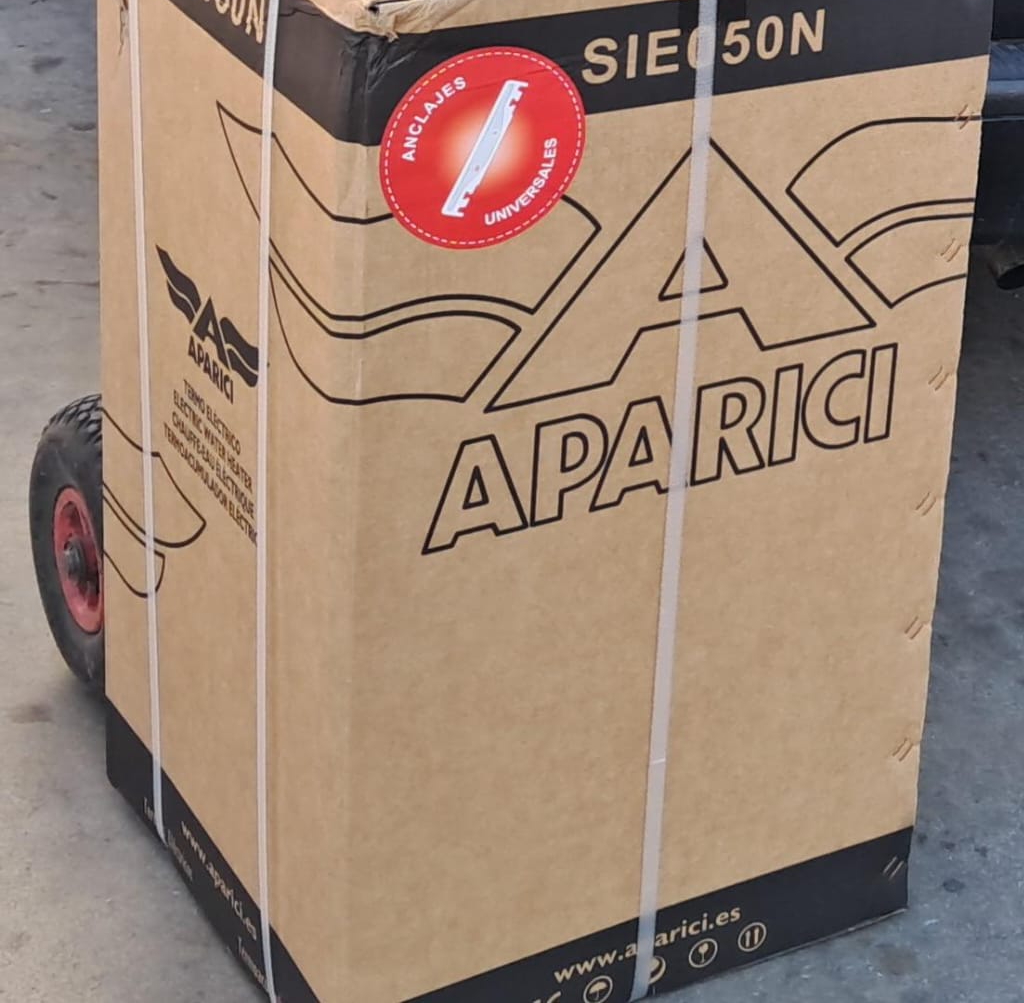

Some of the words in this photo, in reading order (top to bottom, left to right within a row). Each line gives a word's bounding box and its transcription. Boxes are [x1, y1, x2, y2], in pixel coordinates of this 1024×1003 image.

[402, 76, 467, 162] ANCLAJES
[484, 137, 558, 226] UNIVERSALES
[188, 335, 234, 405] APARICI
[421, 342, 898, 555] APARICI
[553, 905, 741, 984] www.aarici.es
